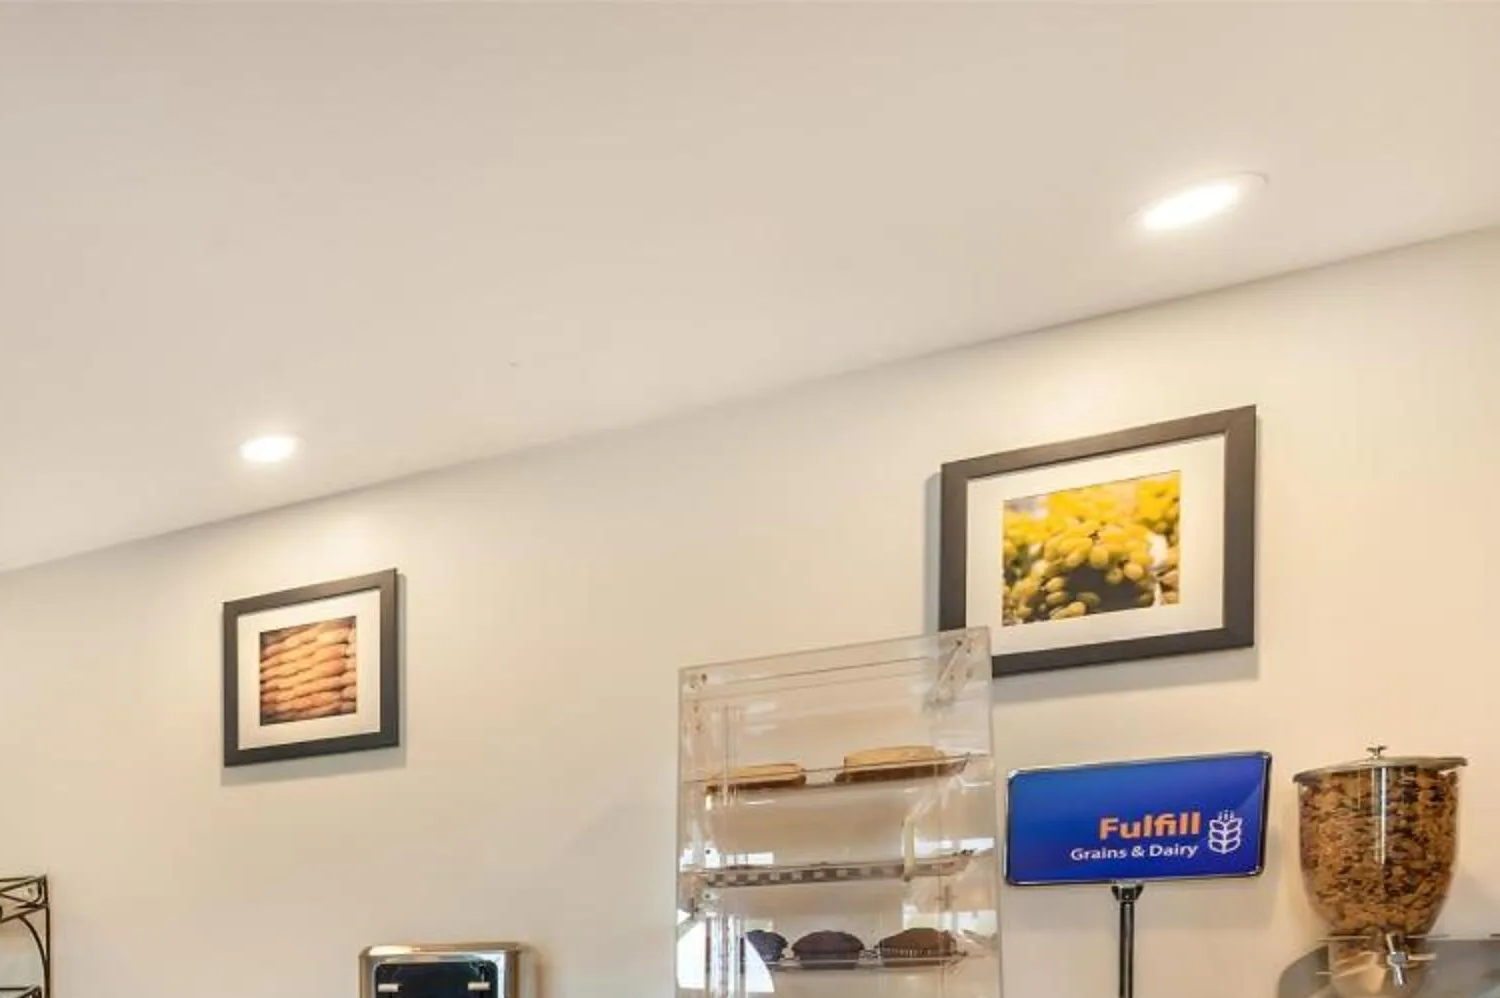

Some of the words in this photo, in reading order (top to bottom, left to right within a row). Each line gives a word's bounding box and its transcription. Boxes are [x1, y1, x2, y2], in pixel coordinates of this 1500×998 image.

[1098, 811, 1200, 840] Fulfill
[1070, 846, 1127, 861] Grains
[1131, 845, 1145, 858] &
[1150, 843, 1199, 859] Dairy
